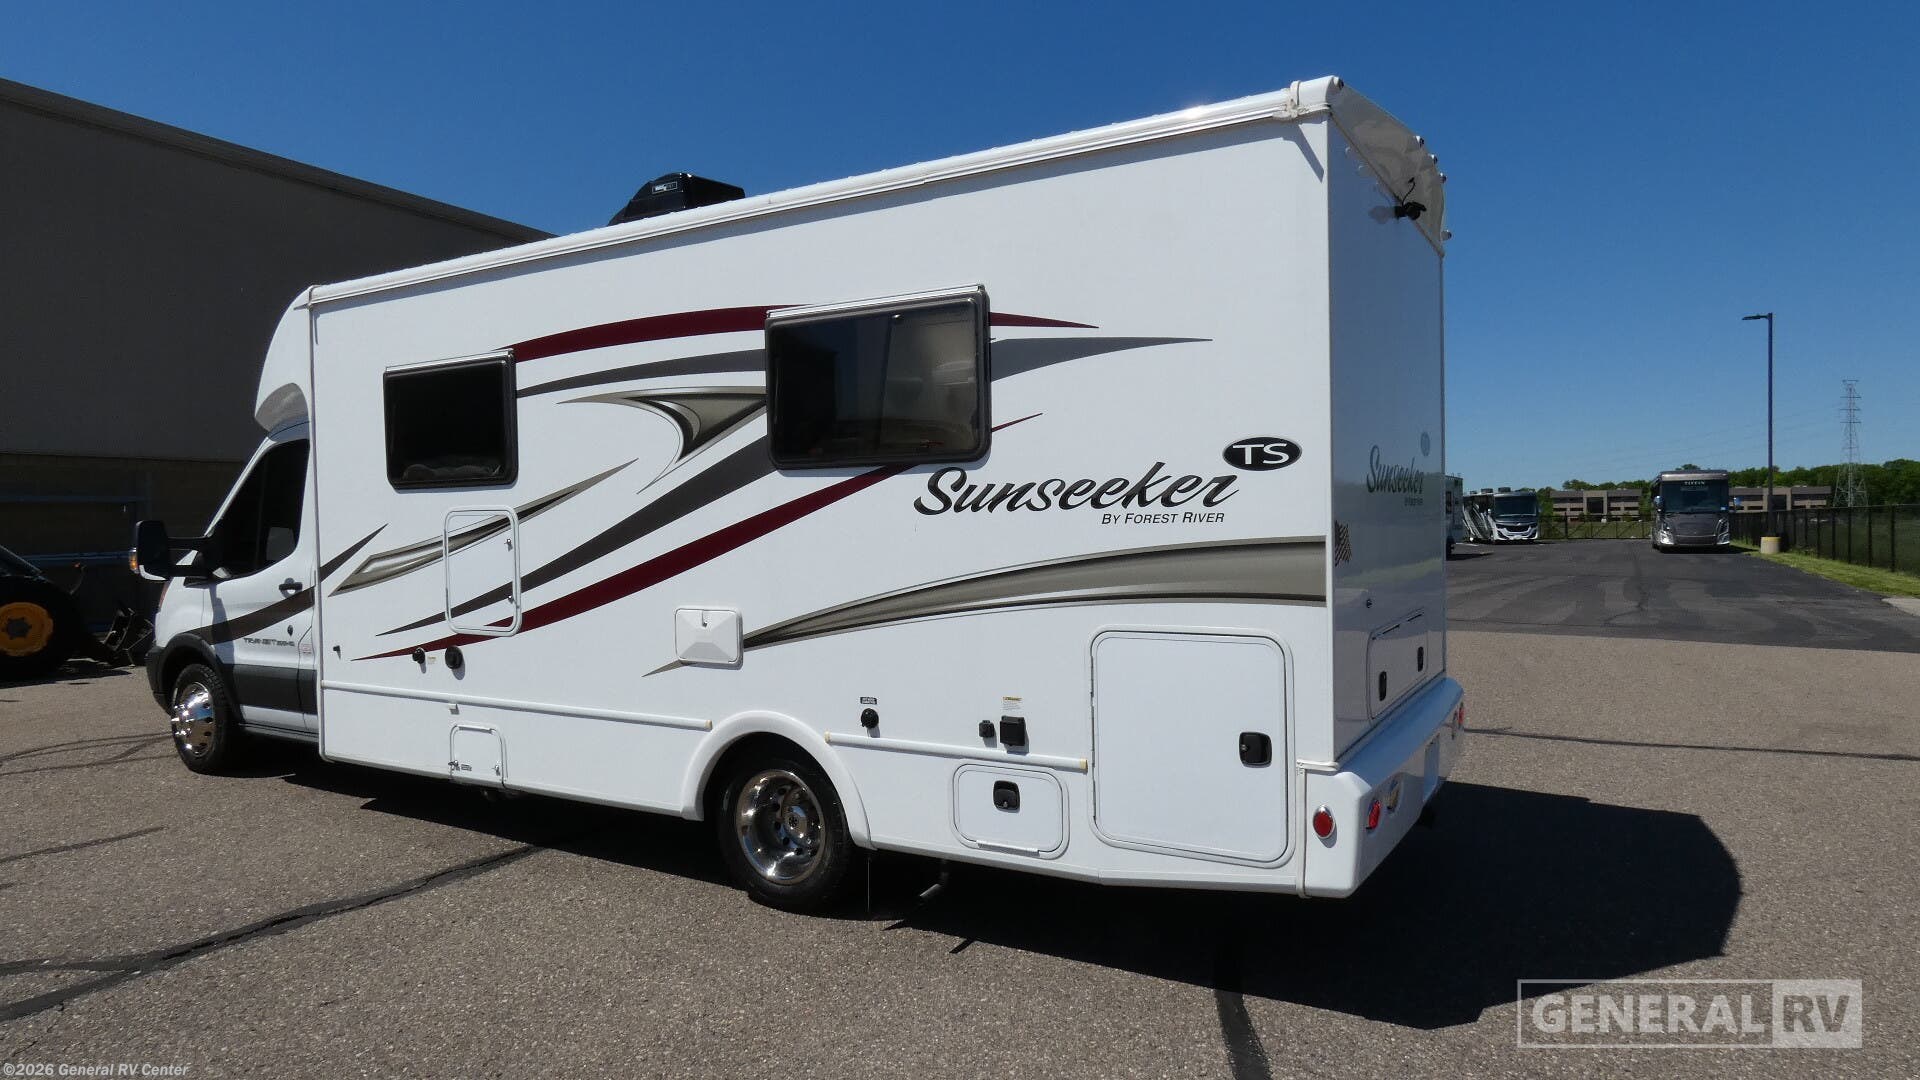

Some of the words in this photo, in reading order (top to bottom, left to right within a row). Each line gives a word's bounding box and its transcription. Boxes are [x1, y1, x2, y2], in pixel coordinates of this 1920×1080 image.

[1232, 442, 1290, 465] TS
[913, 461, 1239, 515] Sunseeker
[1101, 513, 1121, 525] BY
[1125, 512, 1178, 524] FOREST
[1182, 511, 1225, 523] RIVER
